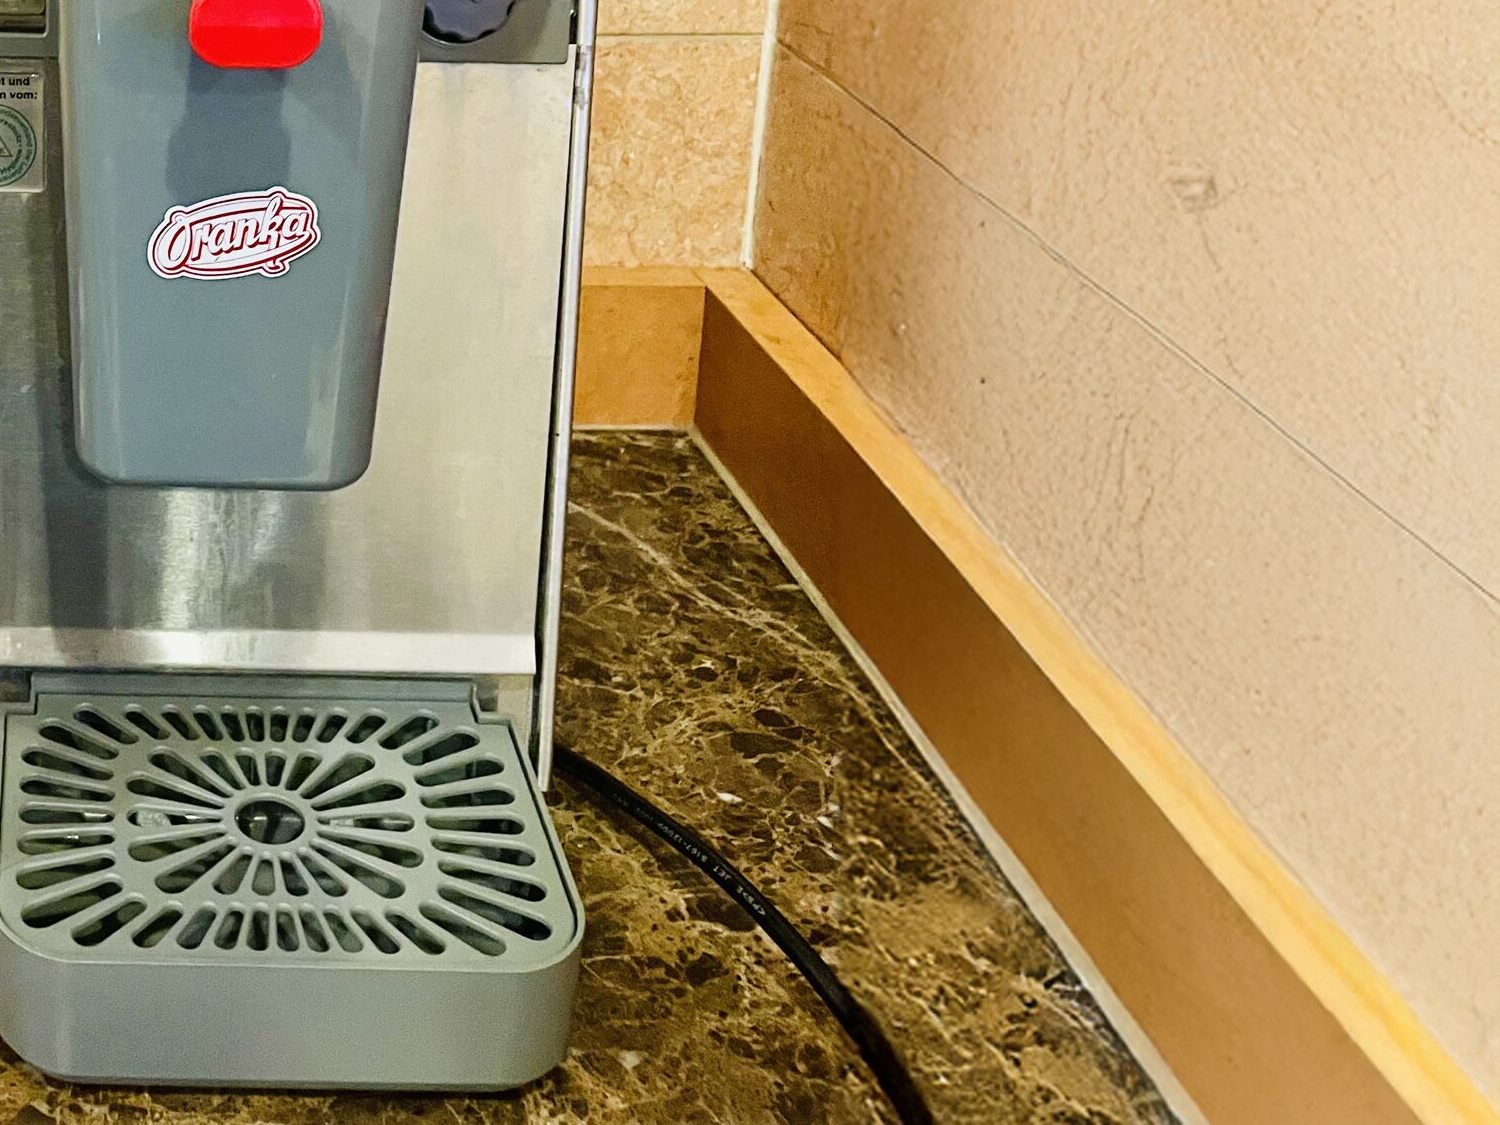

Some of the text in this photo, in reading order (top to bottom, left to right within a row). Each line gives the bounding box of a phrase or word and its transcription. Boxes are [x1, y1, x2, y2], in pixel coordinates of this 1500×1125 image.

[8, 76, 31, 87] und
[9, 90, 38, 100] vom:
[156, 195, 313, 271] Oranka
